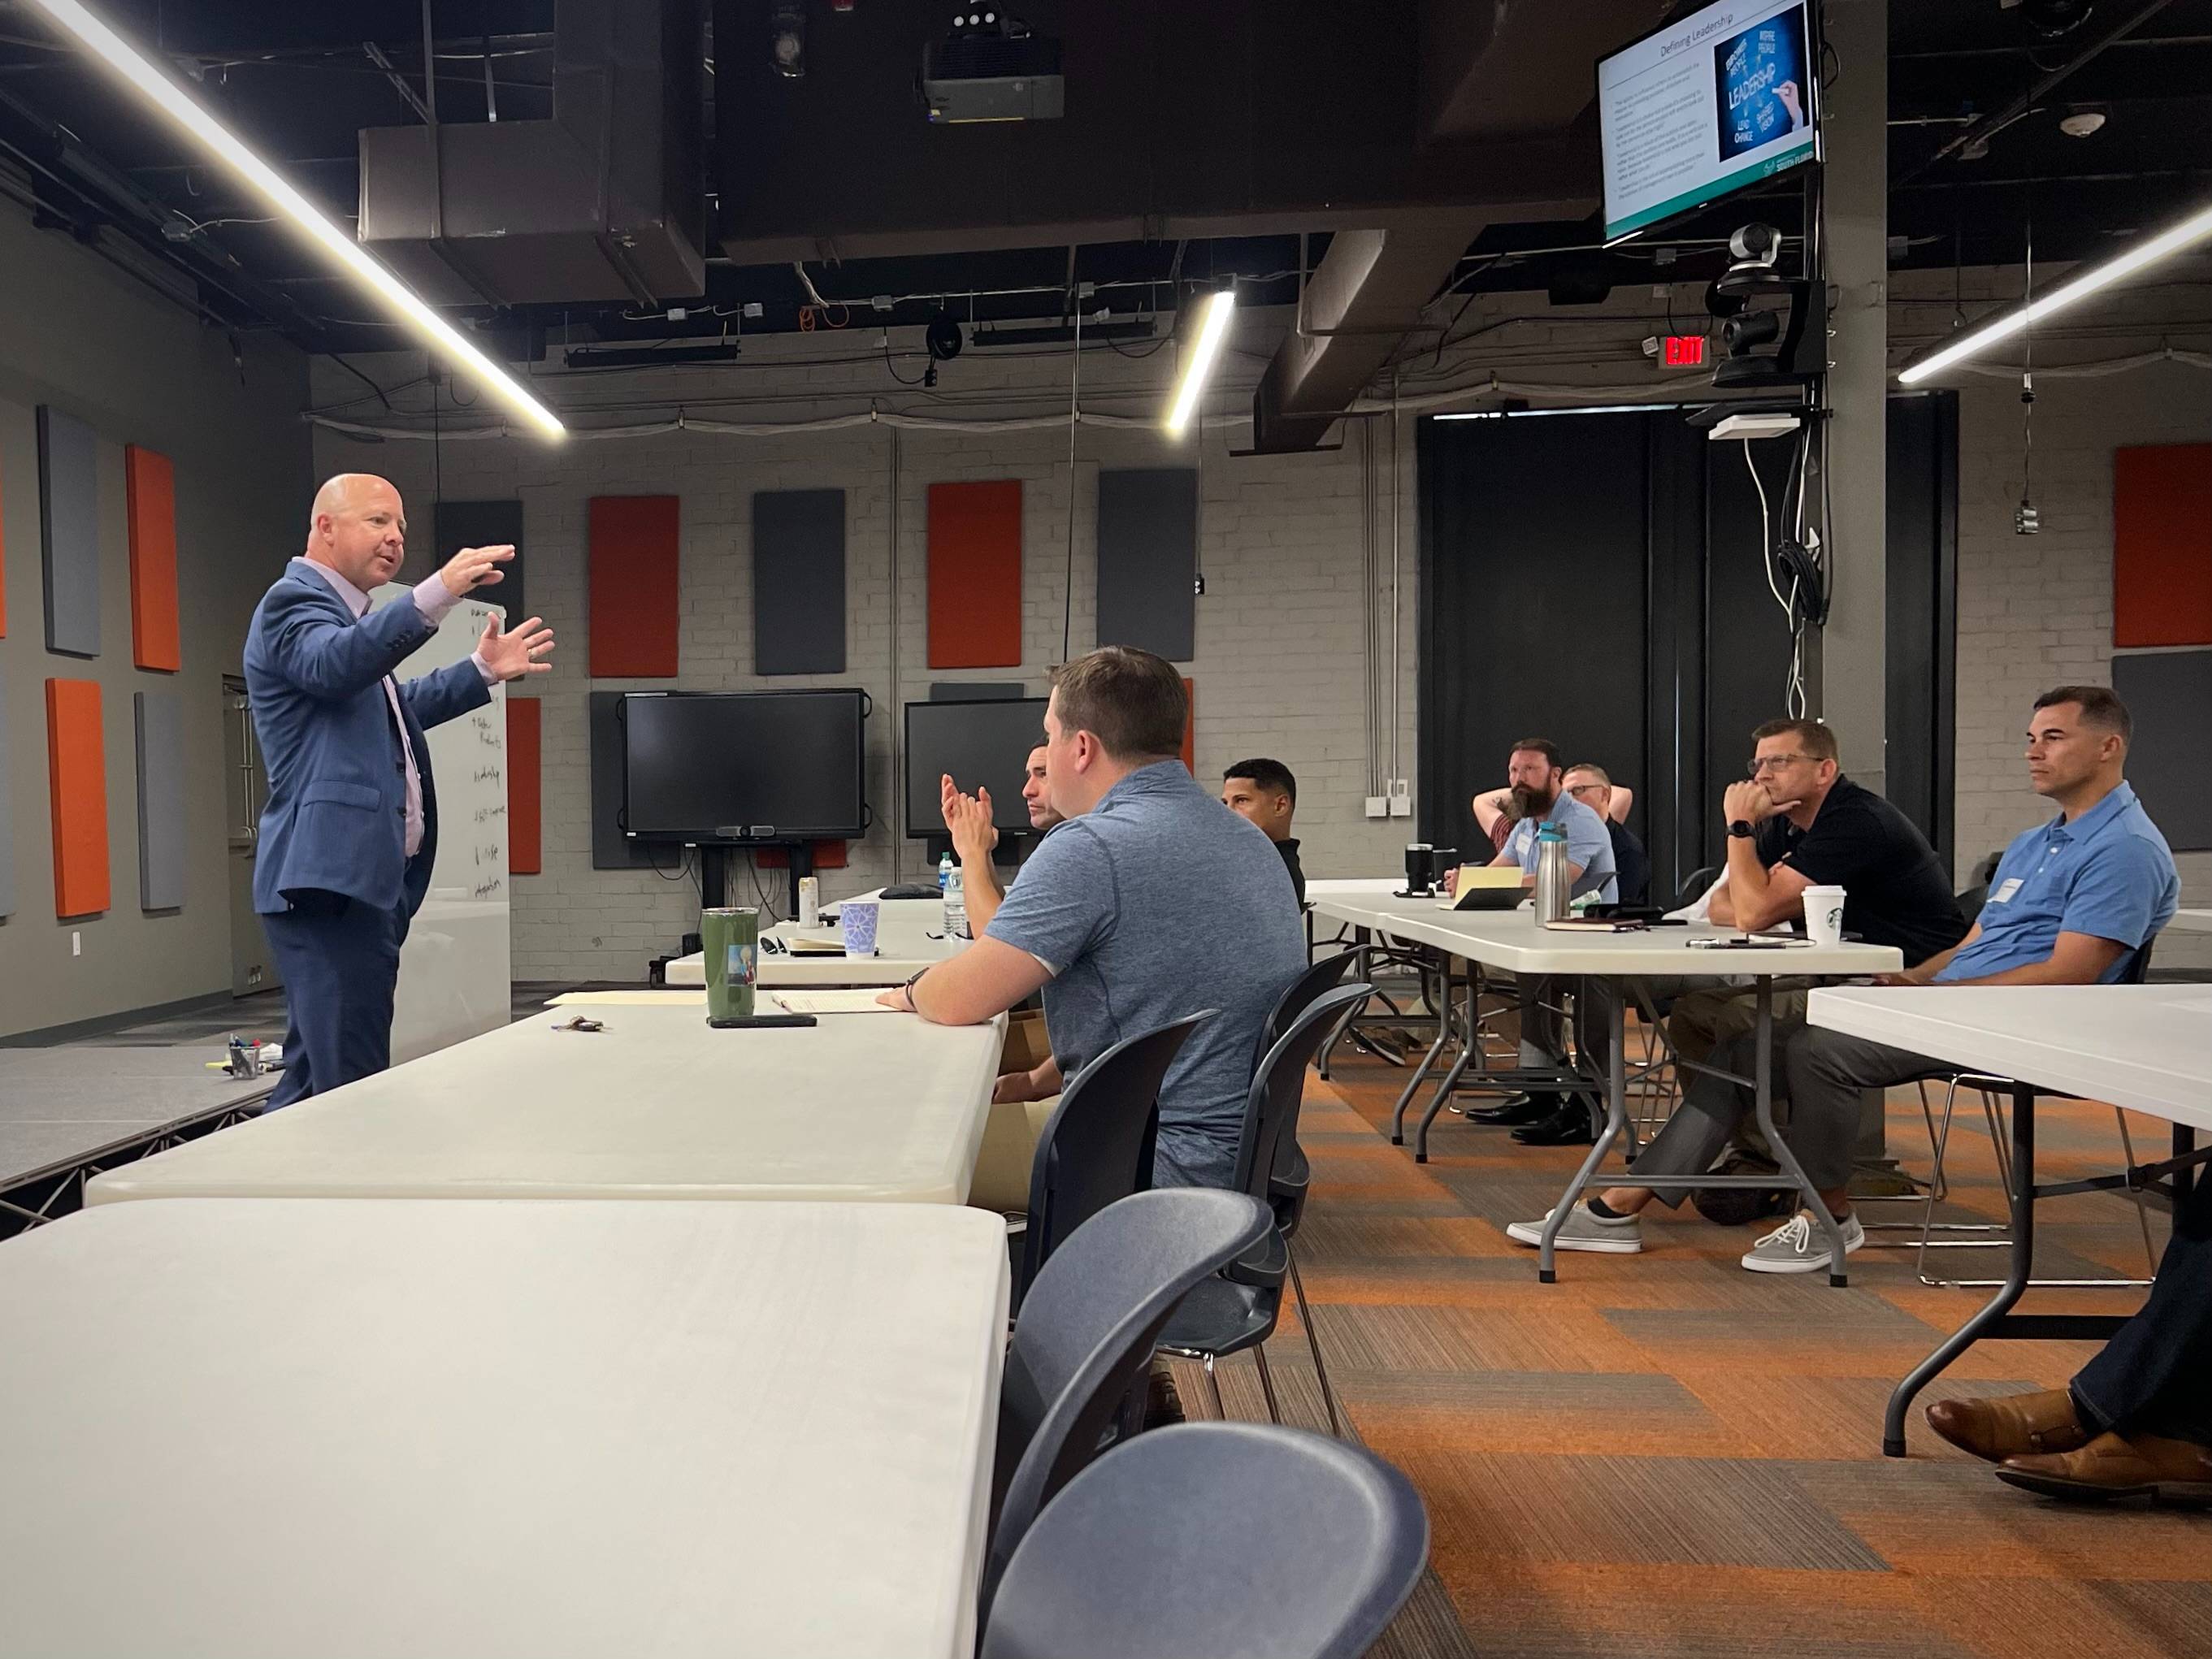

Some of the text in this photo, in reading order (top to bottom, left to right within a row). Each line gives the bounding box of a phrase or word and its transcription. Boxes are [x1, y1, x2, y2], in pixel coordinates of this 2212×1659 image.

[1660, 14, 1733, 58] Defining Leadership
[1728, 62, 1776, 110] LEADERSHIP
[1667, 336, 1704, 365] EXIT
